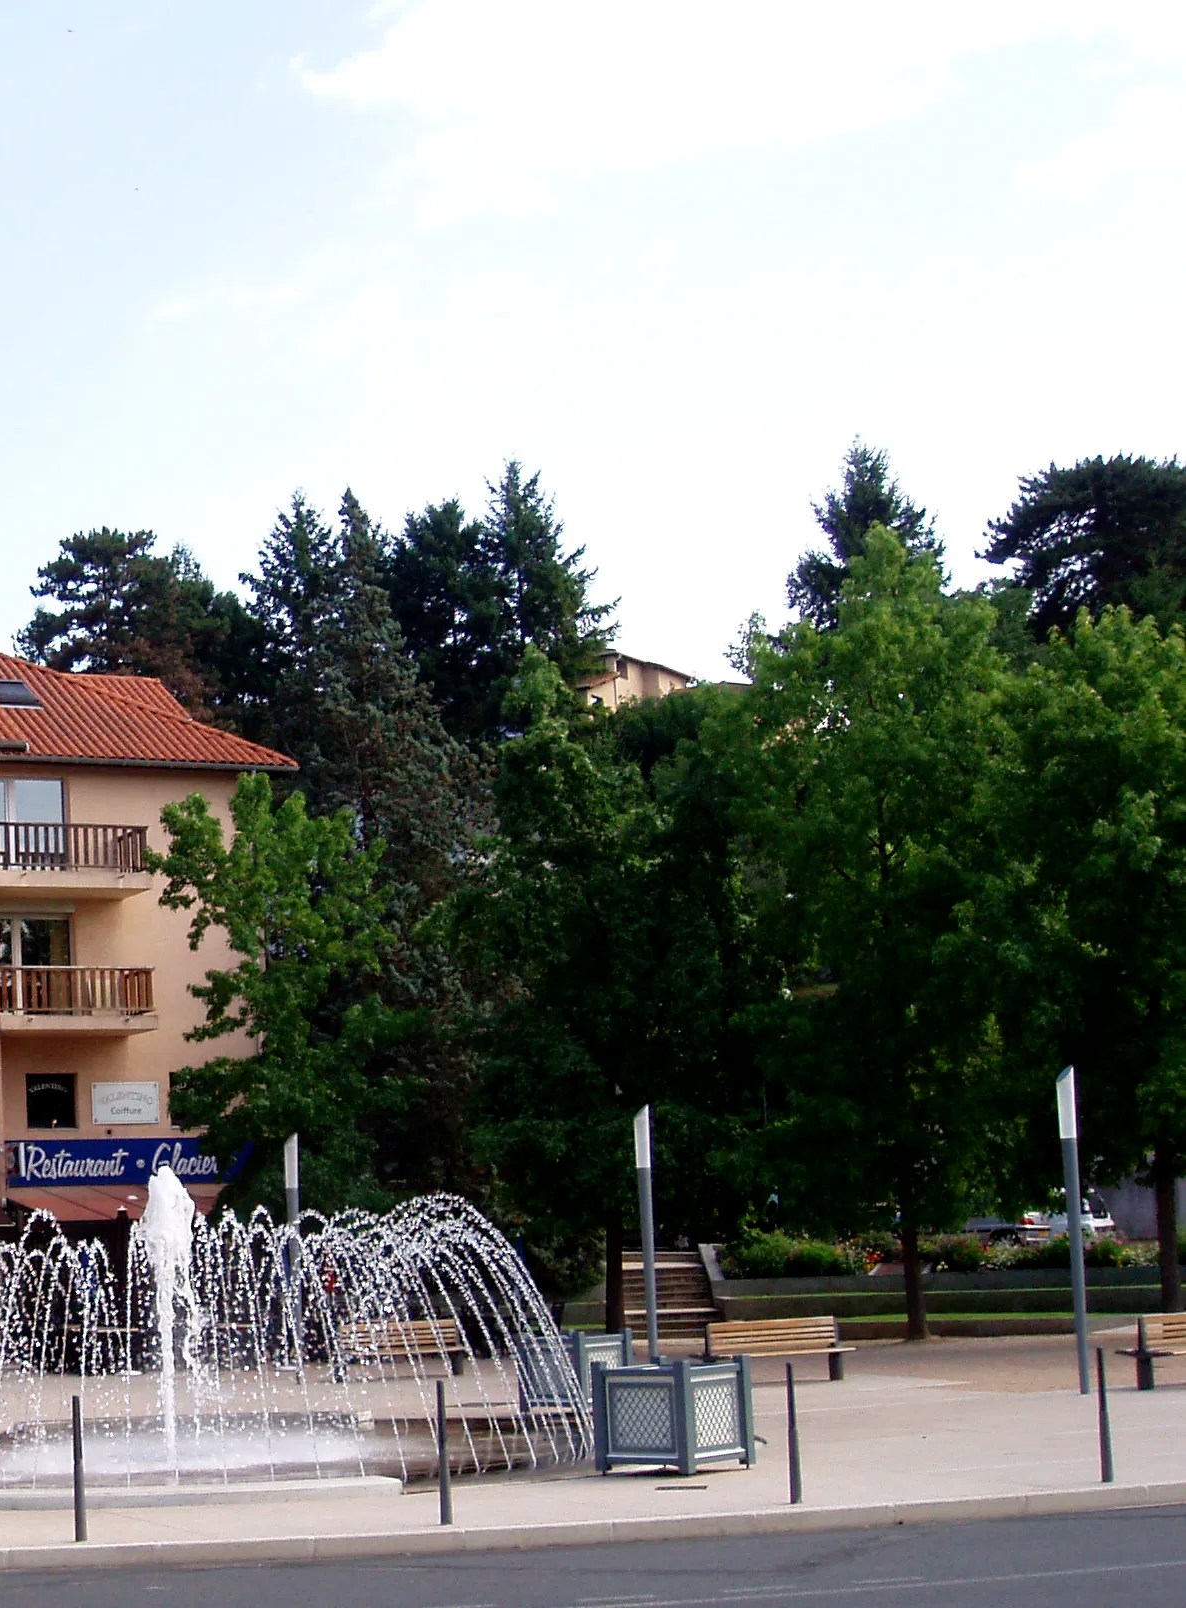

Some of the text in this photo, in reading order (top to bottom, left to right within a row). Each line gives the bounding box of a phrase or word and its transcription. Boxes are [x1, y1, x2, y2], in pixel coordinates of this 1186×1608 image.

[110, 1106, 143, 1115] Coiffure
[25, 1142, 219, 1181] Restaurant Glacier
